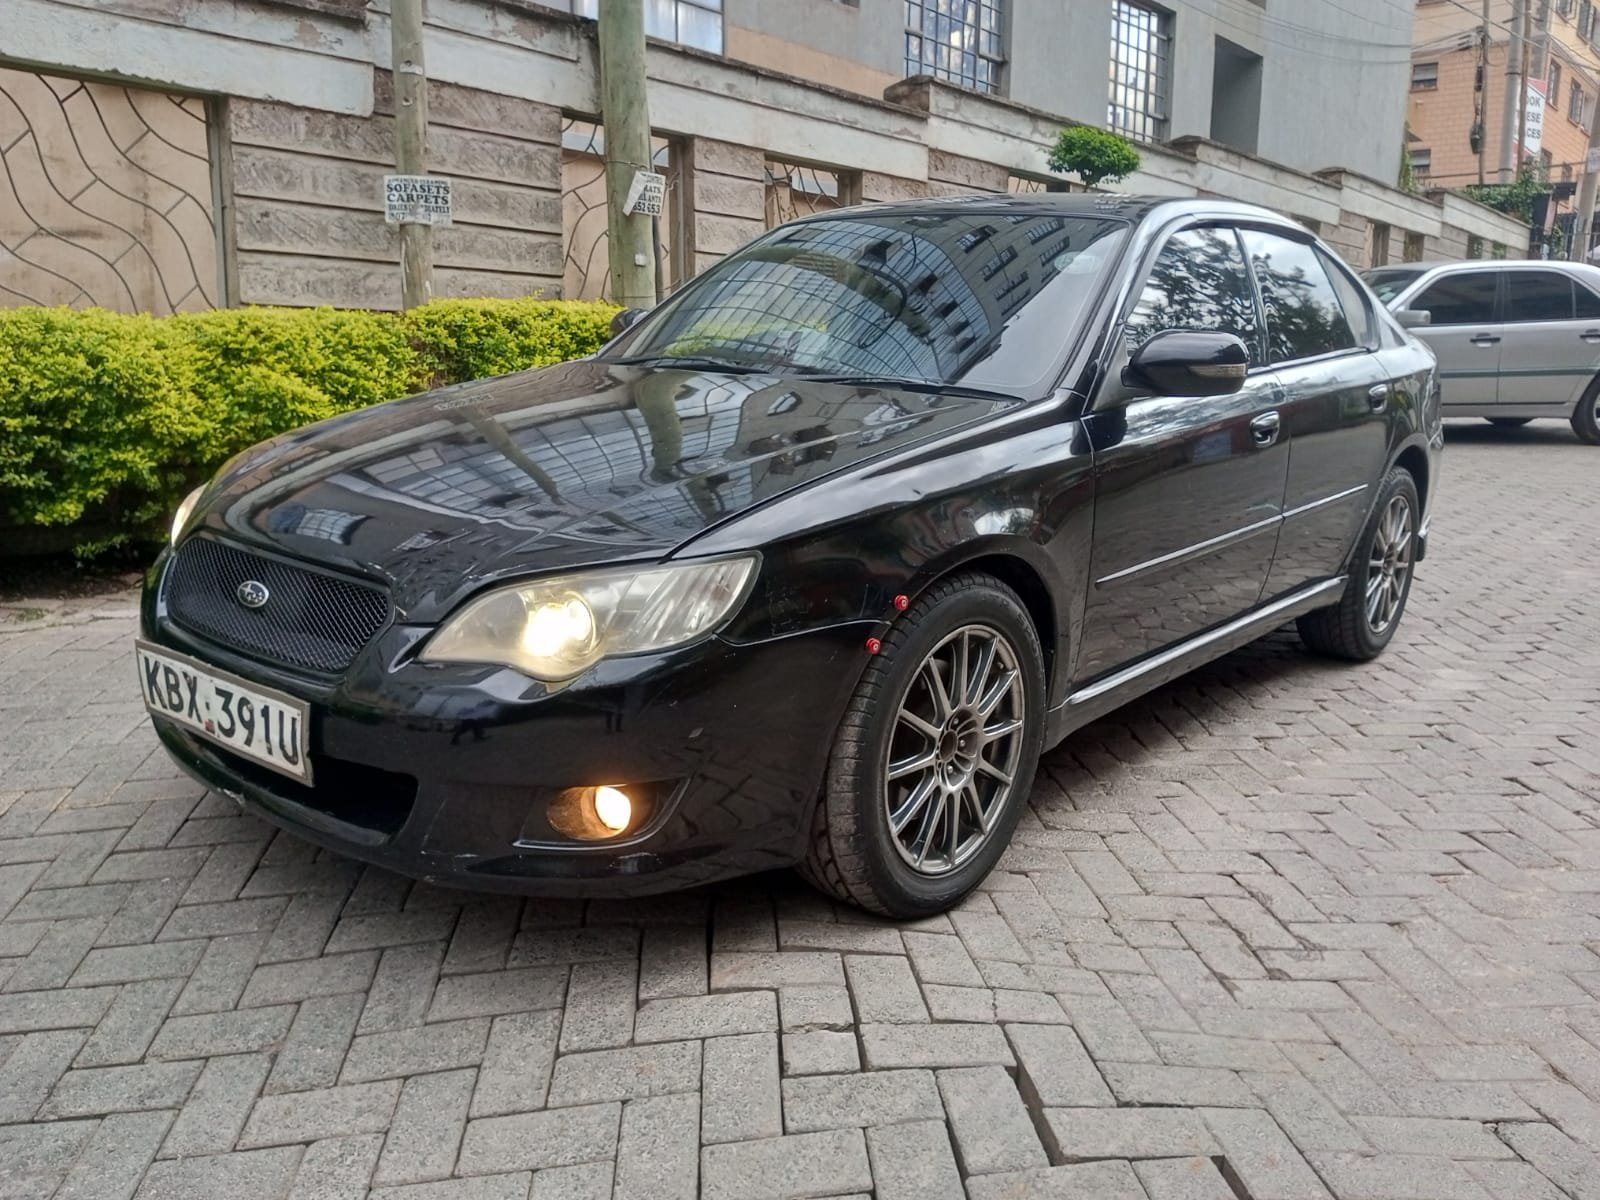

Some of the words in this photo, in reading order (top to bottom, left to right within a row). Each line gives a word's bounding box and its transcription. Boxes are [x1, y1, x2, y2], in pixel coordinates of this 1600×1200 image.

[1526, 111, 1542, 123] ESE
[1526, 127, 1542, 139] CES
[386, 183, 450, 195] SOFASETS
[387, 193, 449, 205] CARPETS
[144, 655, 203, 724] KBX
[214, 686, 300, 766] 391U
